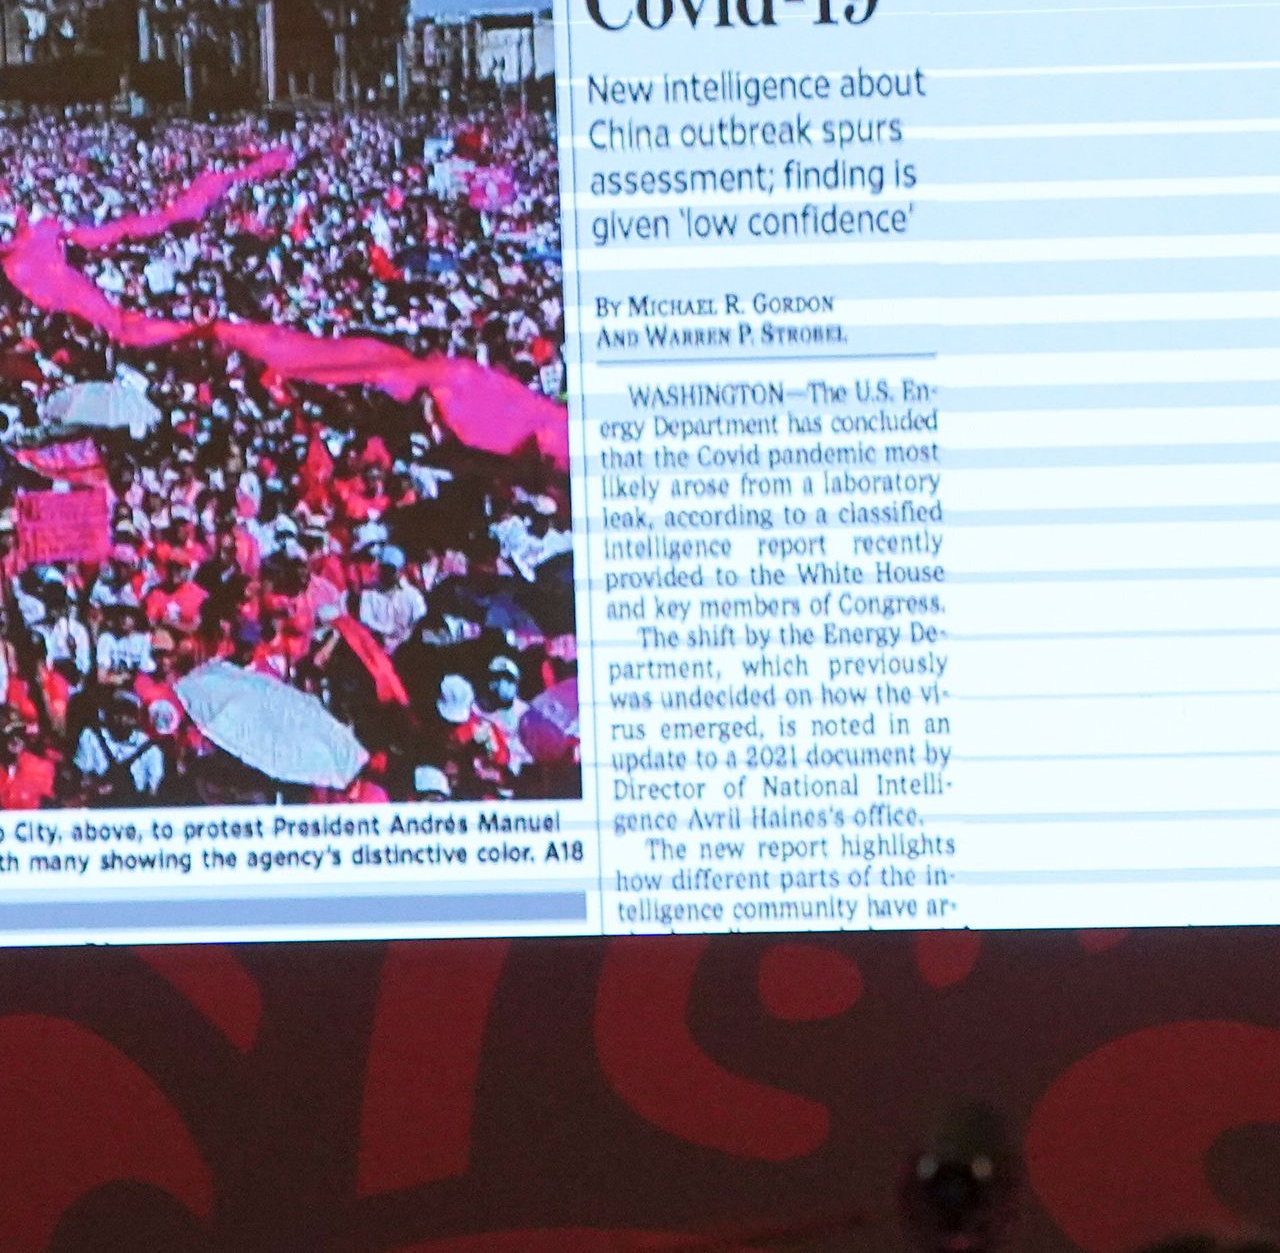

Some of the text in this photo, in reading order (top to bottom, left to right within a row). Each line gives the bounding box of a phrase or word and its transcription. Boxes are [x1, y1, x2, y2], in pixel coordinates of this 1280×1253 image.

[588, 67, 926, 107] New intelligence about
[589, 112, 902, 150] China outbreak spurs
[591, 159, 917, 196] assessment; finding is
[592, 211, 669, 247] given
[855, 378, 893, 402] U.S.
[902, 377, 936, 402] En-
[605, 557, 944, 594] provided to the White House
[15, 820, 61, 846] City,
[72, 820, 142, 843] above,
[152, 820, 172, 841] to
[184, 818, 264, 843] protest
[274, 815, 380, 837] President
[390, 812, 468, 835] Andrés
[478, 810, 560, 833] Manuel
[30, 854, 89, 875] many
[100, 849, 192, 874] showing
[202, 847, 236, 870] the
[247, 845, 342, 872] agency's
[352, 842, 467, 865] distinctive
[477, 842, 534, 864] color.
[544, 839, 583, 862] A18
[645, 832, 956, 862] The new report highlights
